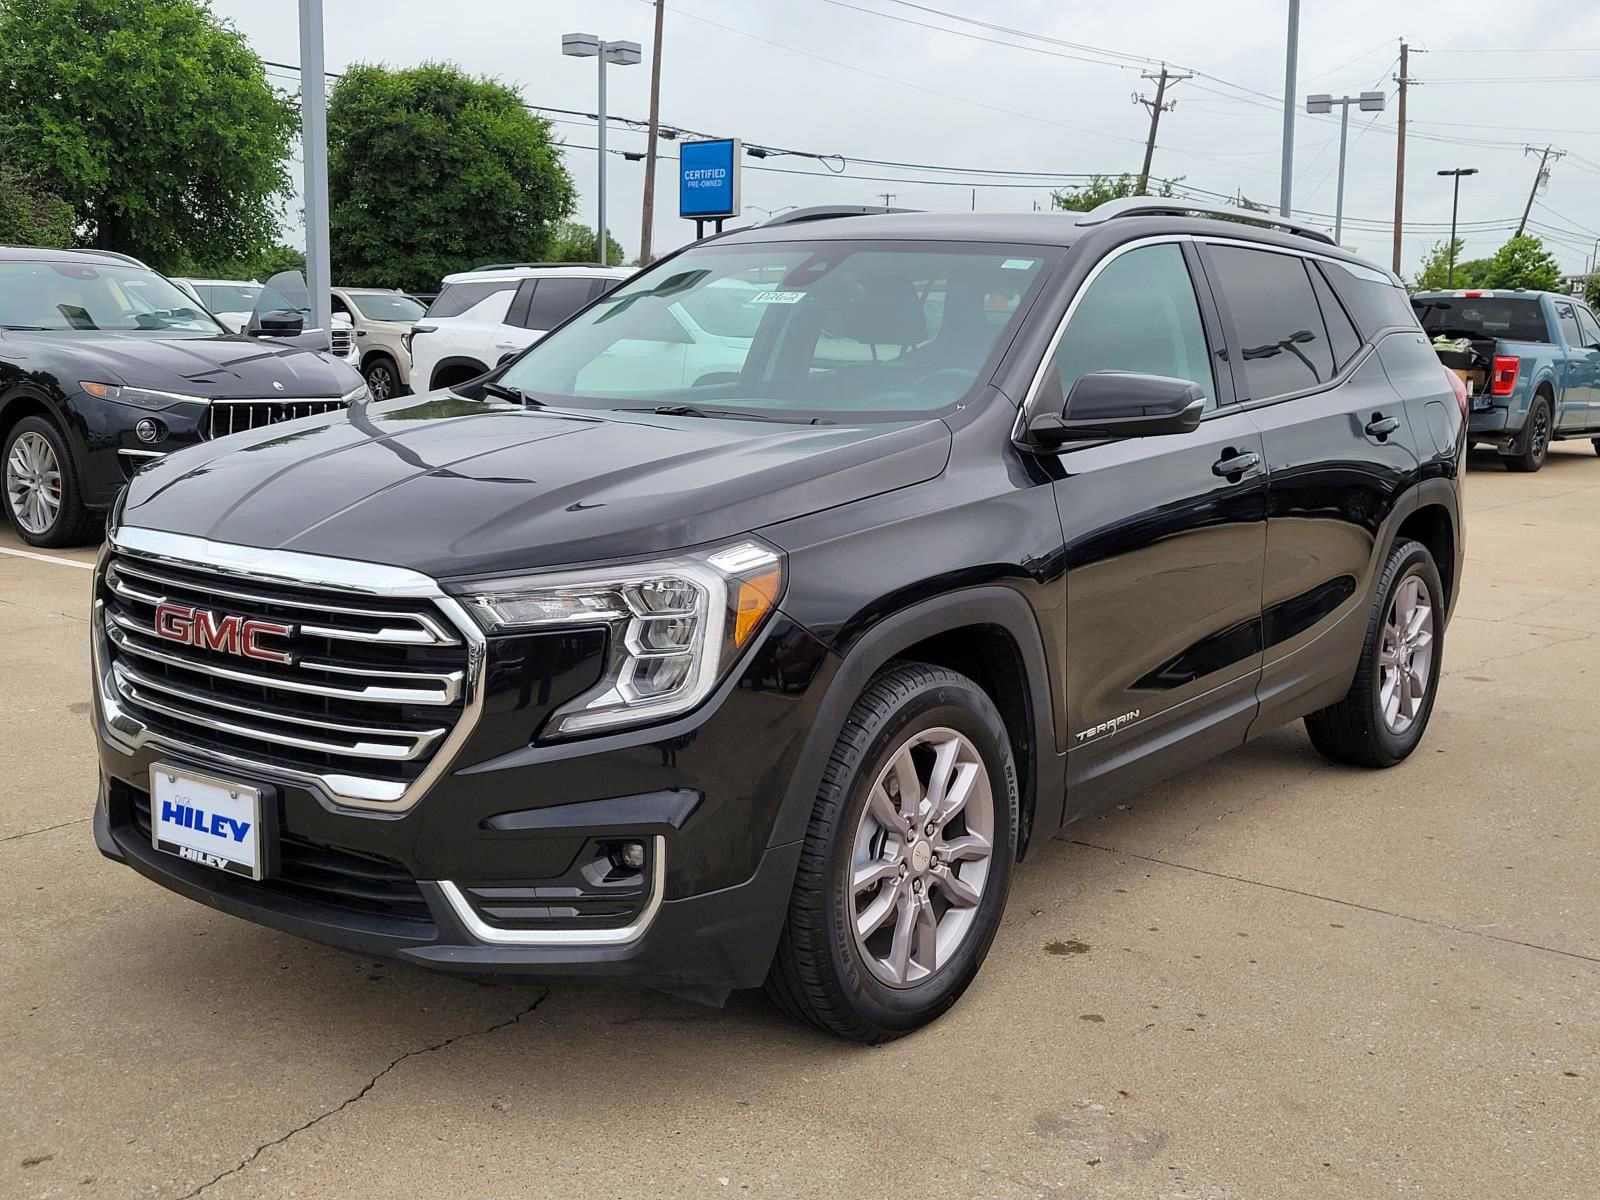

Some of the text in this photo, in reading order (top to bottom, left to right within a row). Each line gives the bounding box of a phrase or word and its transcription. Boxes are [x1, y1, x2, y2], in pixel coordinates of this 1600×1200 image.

[684, 168, 726, 180] CERTIFIED
[687, 179, 723, 188] PRE-OWNED
[155, 602, 294, 665] GMC
[1075, 709, 1140, 740] TERRAIN
[161, 800, 251, 843] HILEY
[180, 846, 230, 869] HILEY
